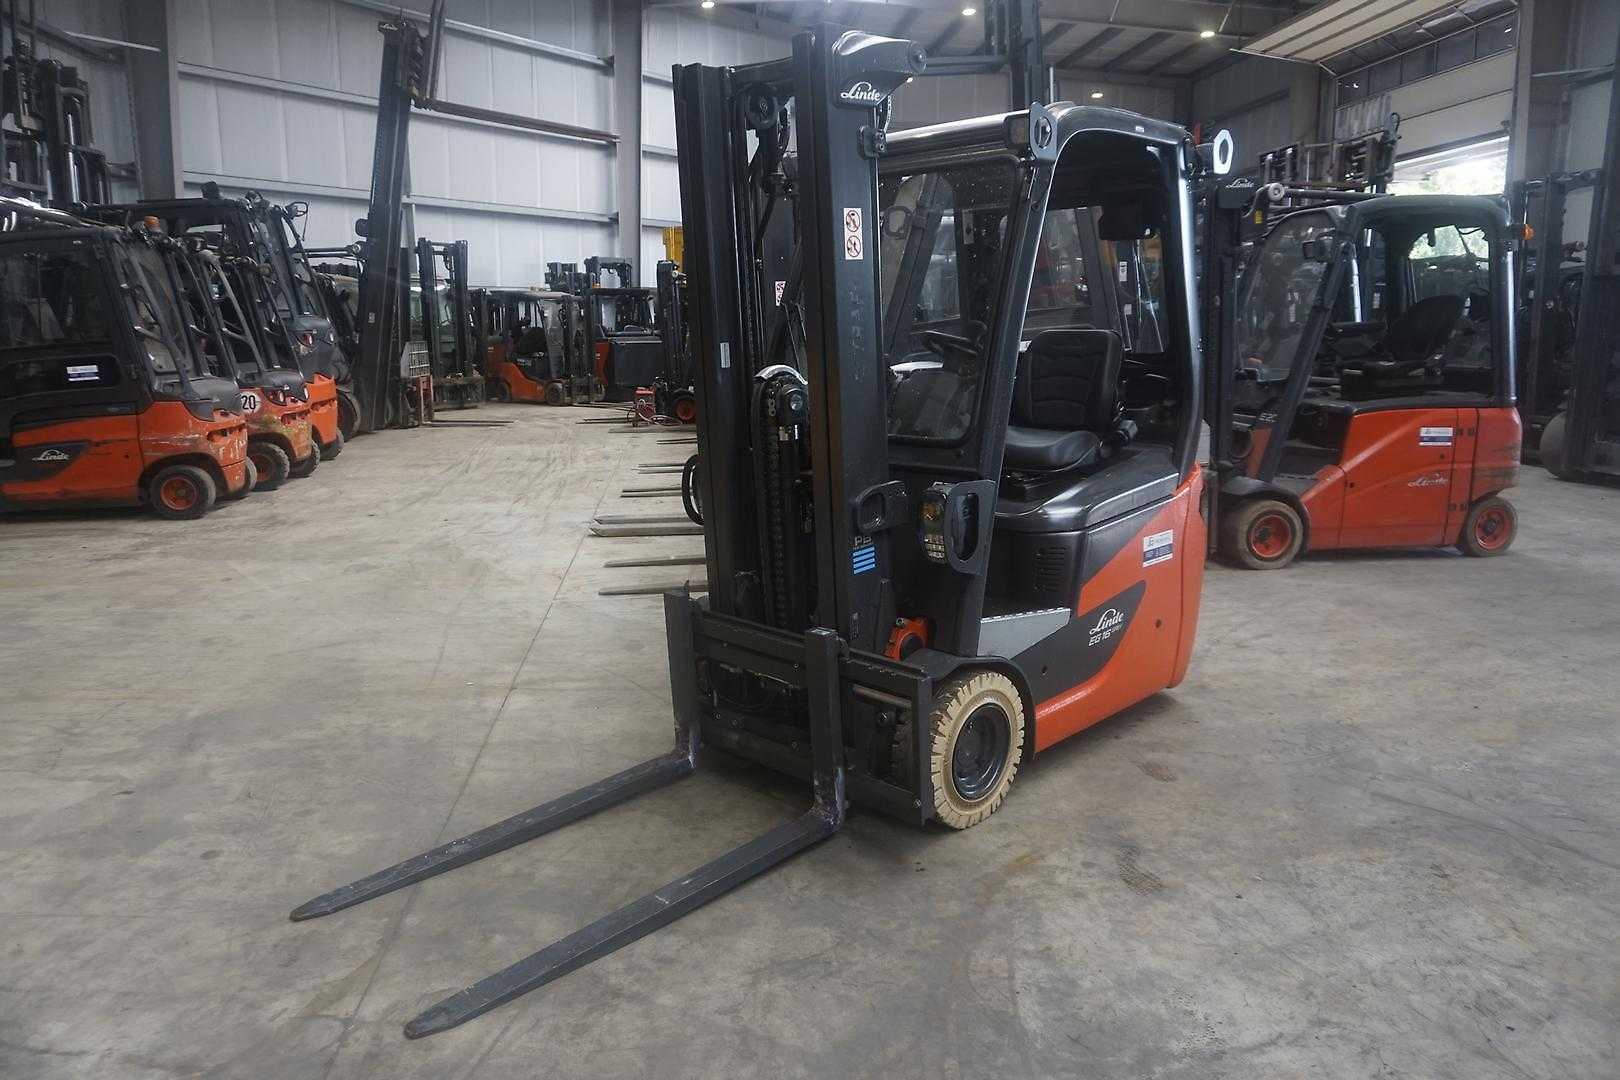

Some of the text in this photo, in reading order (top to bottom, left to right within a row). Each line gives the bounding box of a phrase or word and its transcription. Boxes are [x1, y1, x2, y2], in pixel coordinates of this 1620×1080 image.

[840, 81, 881, 101] Linde
[1225, 177, 1254, 188] Linde
[241, 394, 256, 410] 20
[32, 449, 70, 461] Linde
[1089, 608, 1124, 635] Linde
[1088, 633, 1102, 647] EG
